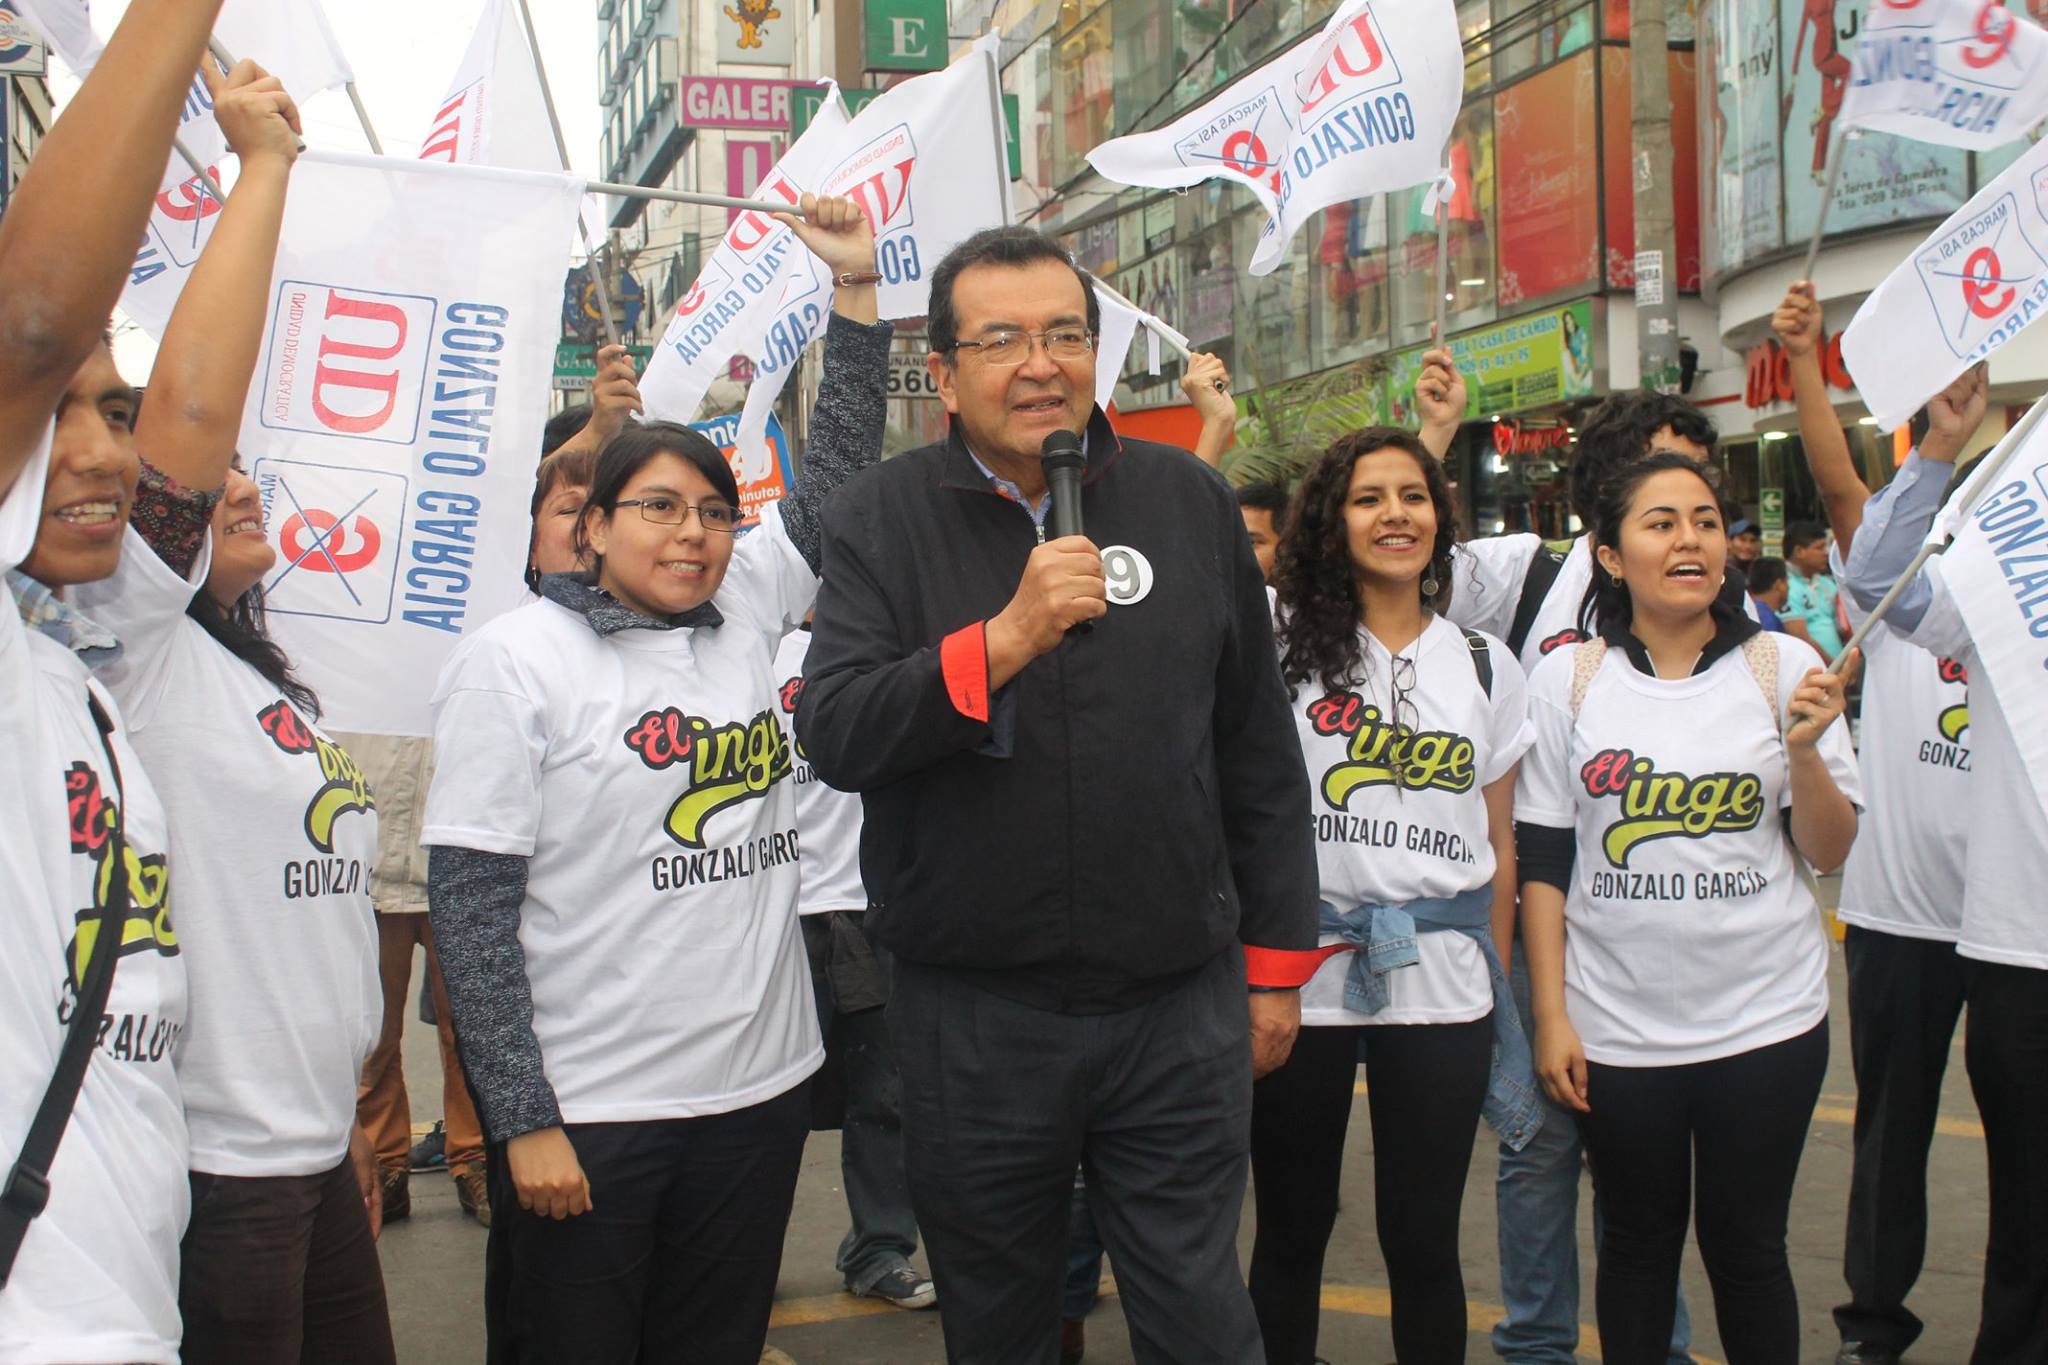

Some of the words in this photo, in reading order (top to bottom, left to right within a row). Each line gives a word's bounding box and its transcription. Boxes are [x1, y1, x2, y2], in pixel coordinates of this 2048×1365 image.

[887, 17, 928, 57] E
[1103, 549, 1140, 600] 9
[625, 706, 692, 770] El
[1919, 740, 1971, 772] GONZ
[1581, 749, 1632, 798] El
[1621, 758, 1764, 838] inge
[652, 838, 755, 890] GONZALO
[1592, 872, 1685, 901] GONZALO
